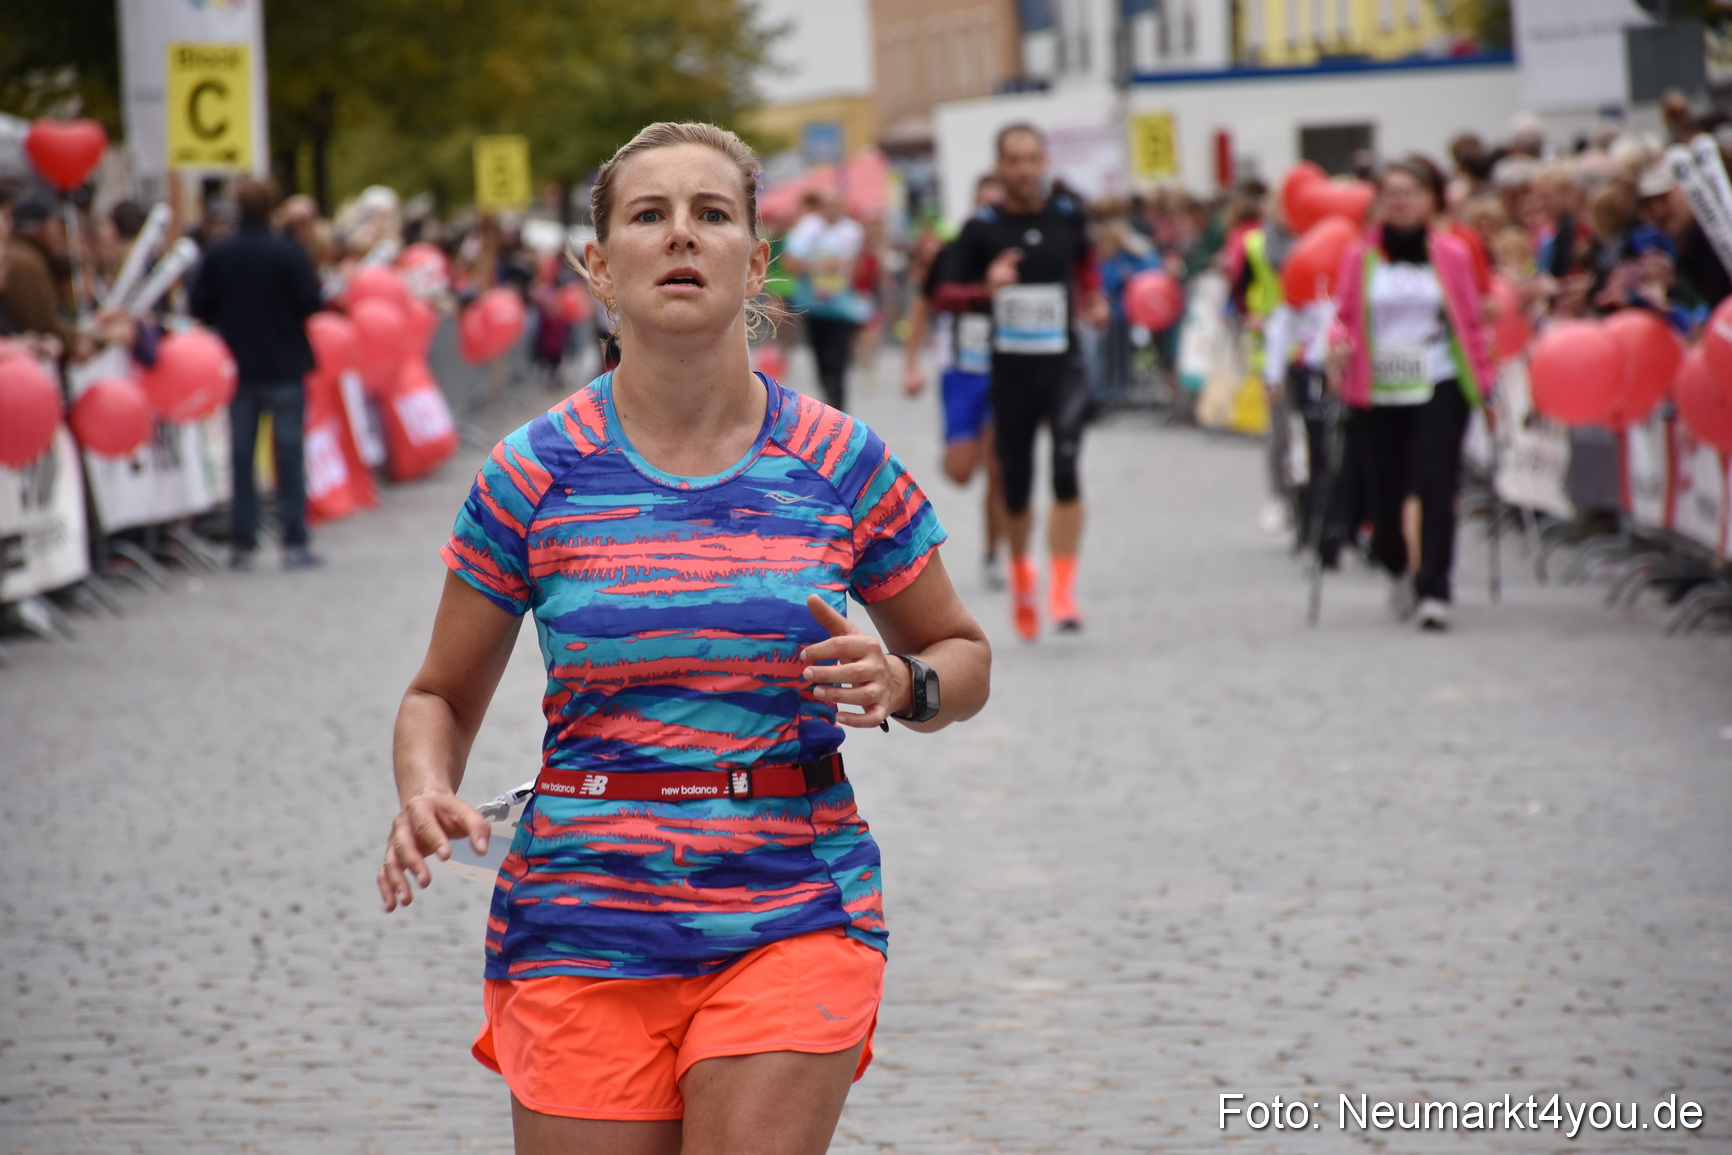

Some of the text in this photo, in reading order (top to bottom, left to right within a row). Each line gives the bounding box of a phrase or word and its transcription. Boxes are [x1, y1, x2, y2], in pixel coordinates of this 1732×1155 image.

[187, 80, 230, 140] C
[540, 782, 550, 791] new
[550, 782, 576, 794] balance
[661, 786, 680, 795] new
[681, 785, 718, 795] balance
